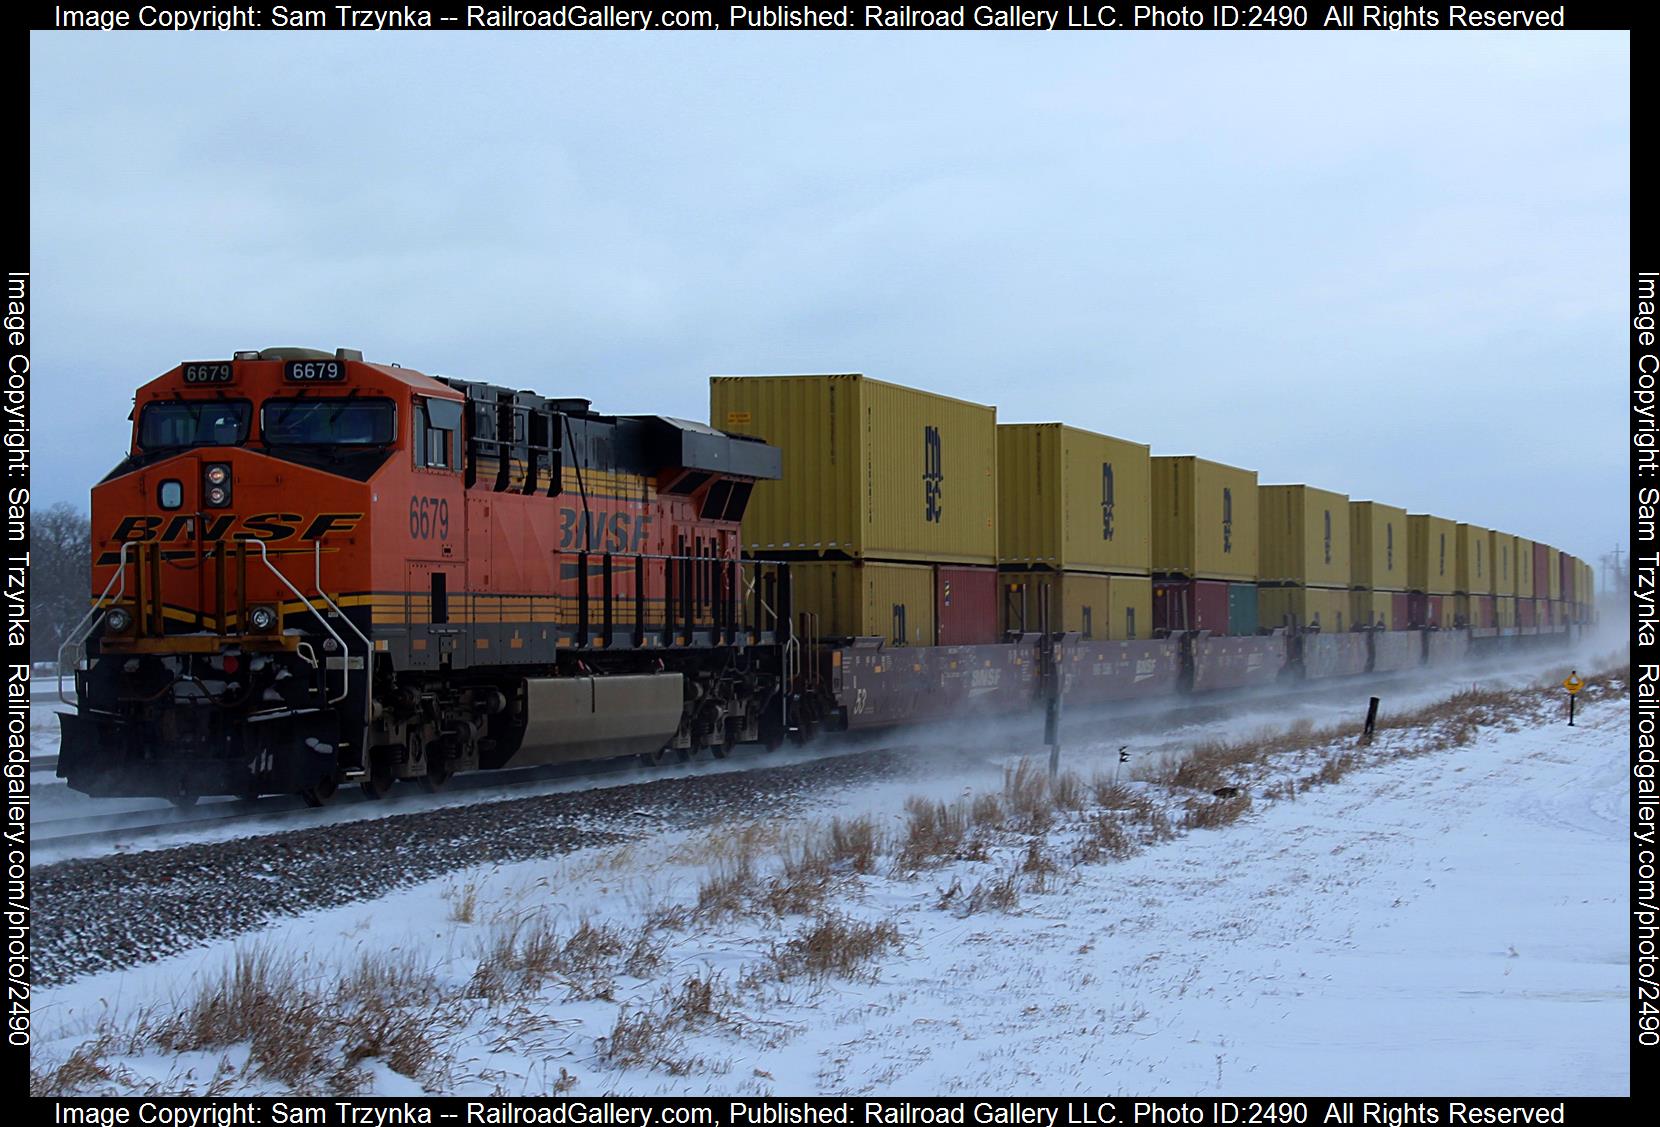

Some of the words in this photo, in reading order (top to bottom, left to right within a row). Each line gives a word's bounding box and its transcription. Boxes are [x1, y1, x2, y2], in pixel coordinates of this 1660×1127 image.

[186, 364, 230, 383] 6679
[293, 362, 338, 380] 6679
[111, 512, 365, 542] BNSF
[409, 496, 449, 541] 6679
[560, 507, 653, 552] BNSF
